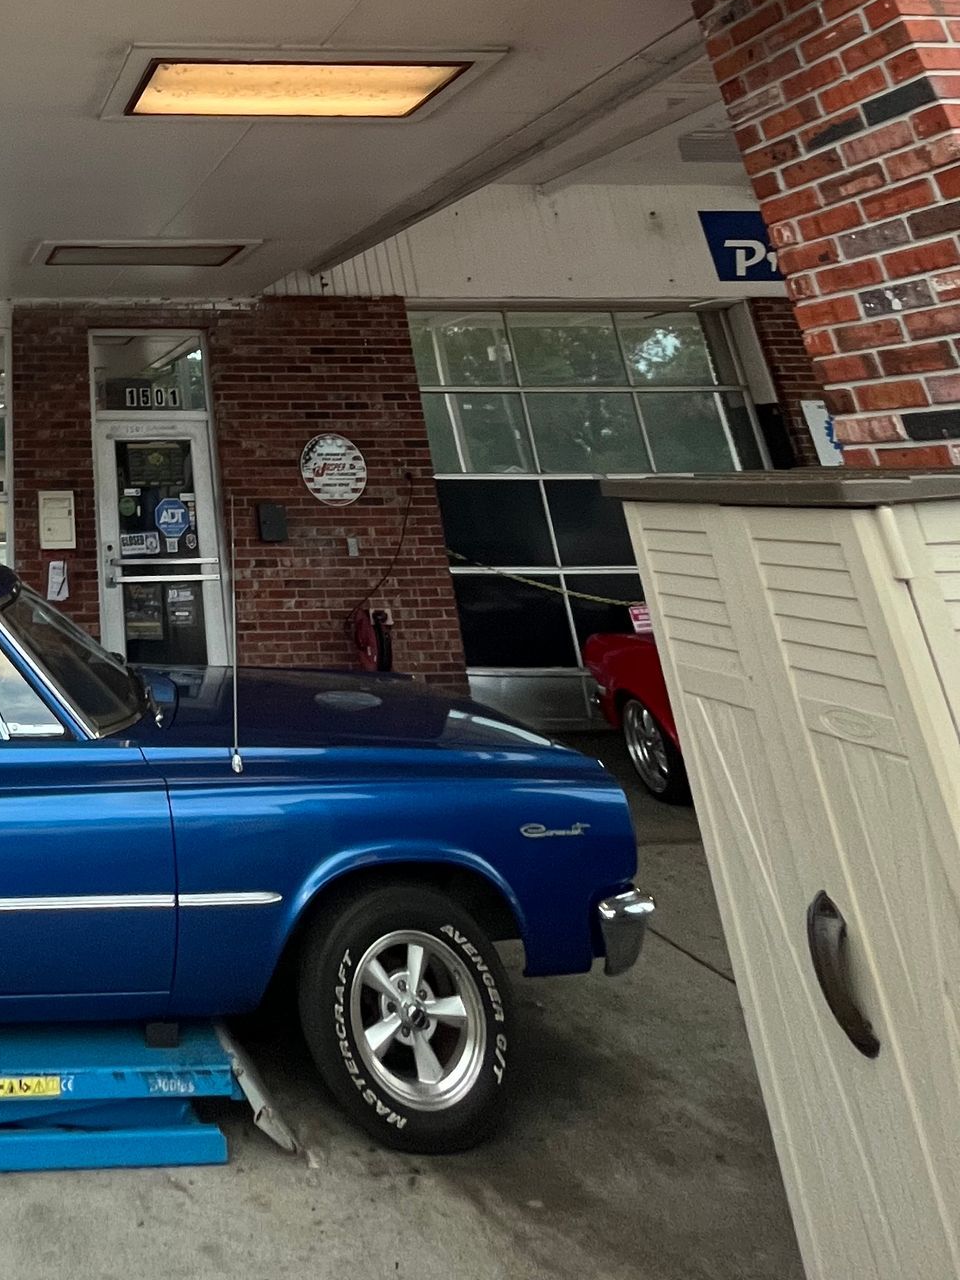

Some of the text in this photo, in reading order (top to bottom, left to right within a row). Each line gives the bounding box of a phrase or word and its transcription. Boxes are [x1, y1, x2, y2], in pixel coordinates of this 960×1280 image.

[127, 388, 179, 406] 1501
[160, 509, 185, 524] ADT
[440, 924, 505, 1022] AVENGER
[334, 948, 408, 1129] MASTERCRAFT
